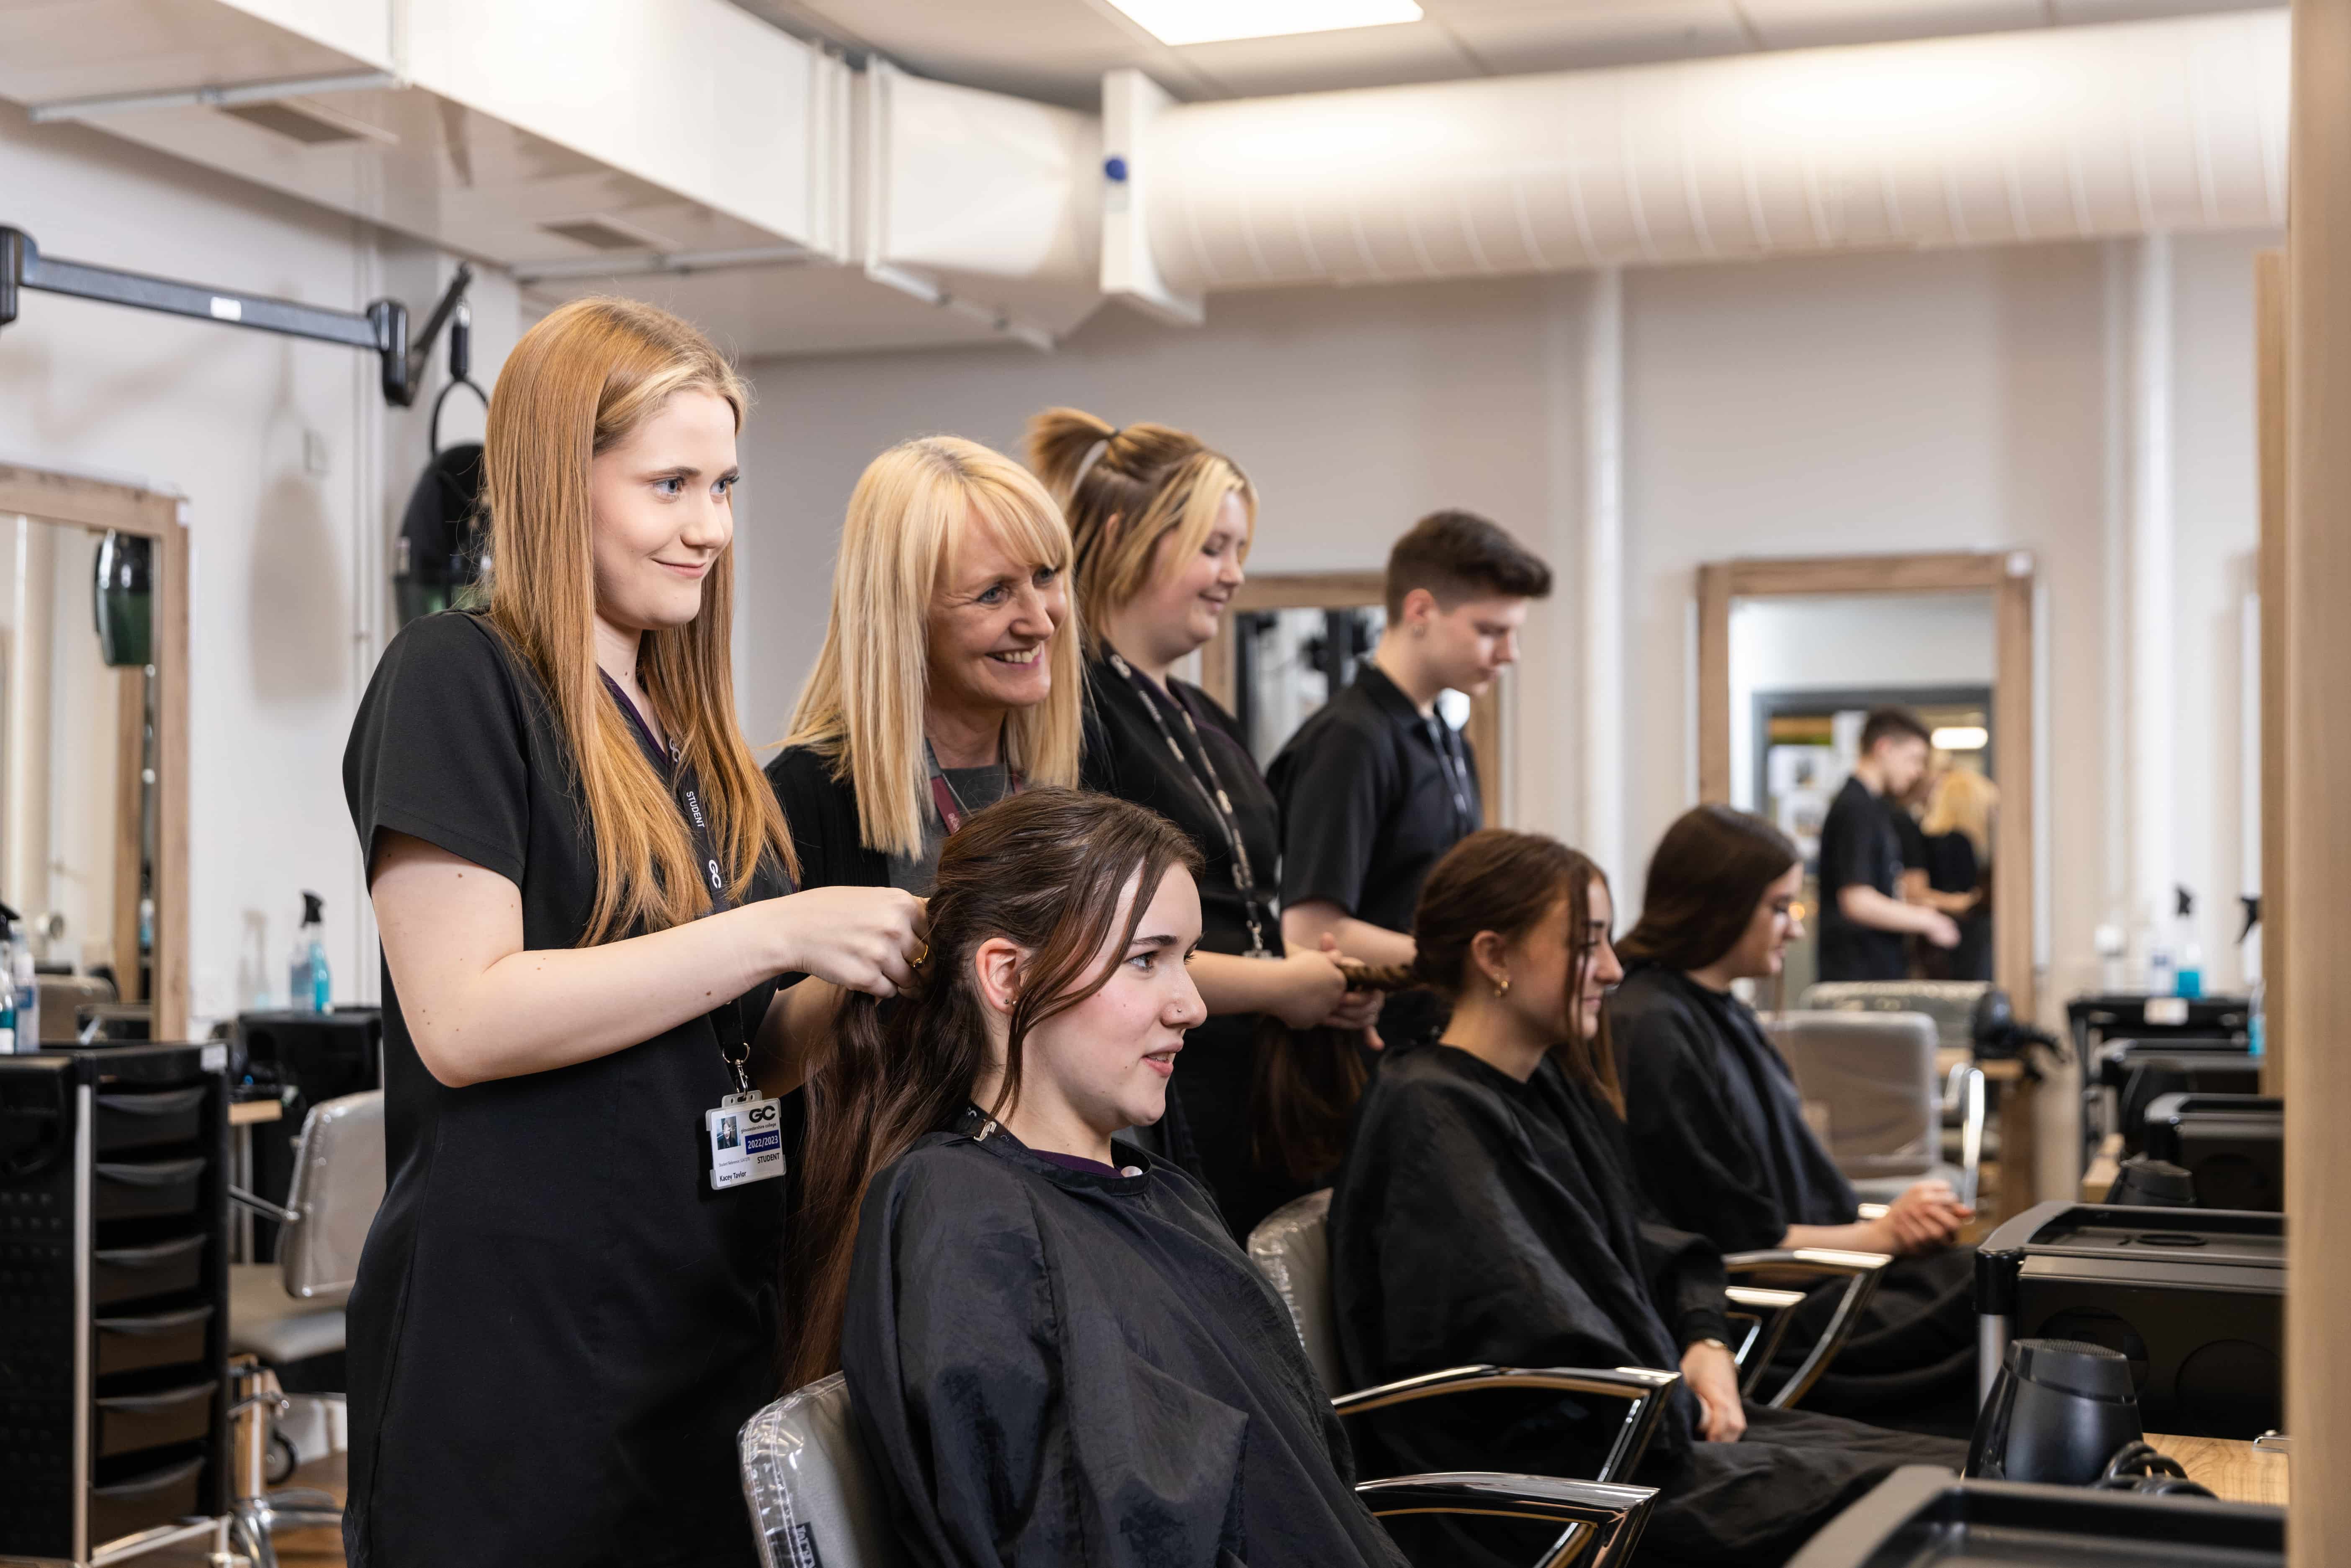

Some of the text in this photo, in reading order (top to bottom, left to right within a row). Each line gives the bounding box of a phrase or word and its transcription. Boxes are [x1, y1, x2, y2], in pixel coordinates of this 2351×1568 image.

[687, 791, 705, 827] STUDENT
[709, 859, 721, 889] GC
[749, 1105, 776, 1123] GC
[741, 1125, 764, 1134] gloucestershire
[748, 1135, 778, 1149] 2022/2023
[757, 1152, 779, 1164] STUDENT
